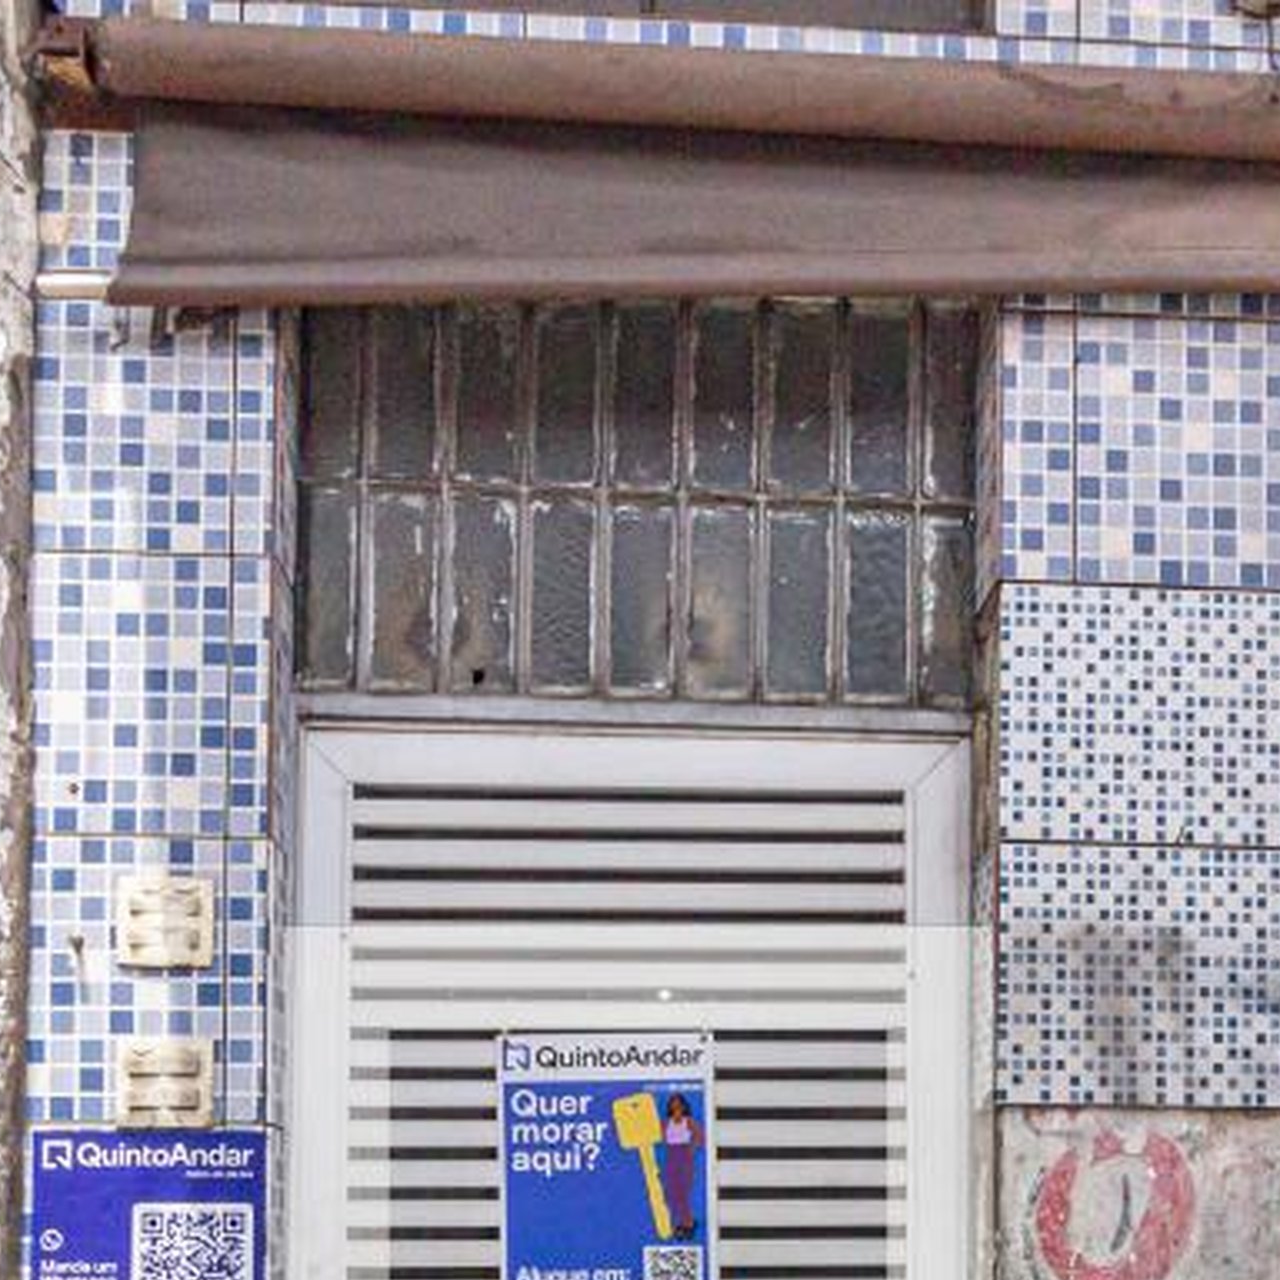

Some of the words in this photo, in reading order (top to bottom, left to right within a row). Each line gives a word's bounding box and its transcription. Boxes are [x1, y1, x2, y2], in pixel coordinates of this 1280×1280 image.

[535, 1044, 705, 1068] QuintoAndar
[511, 1088, 593, 1116] Quer
[512, 1120, 608, 1144] morar
[76, 1142, 254, 1168] QuintoAndar
[511, 1143, 601, 1179] aqui?
